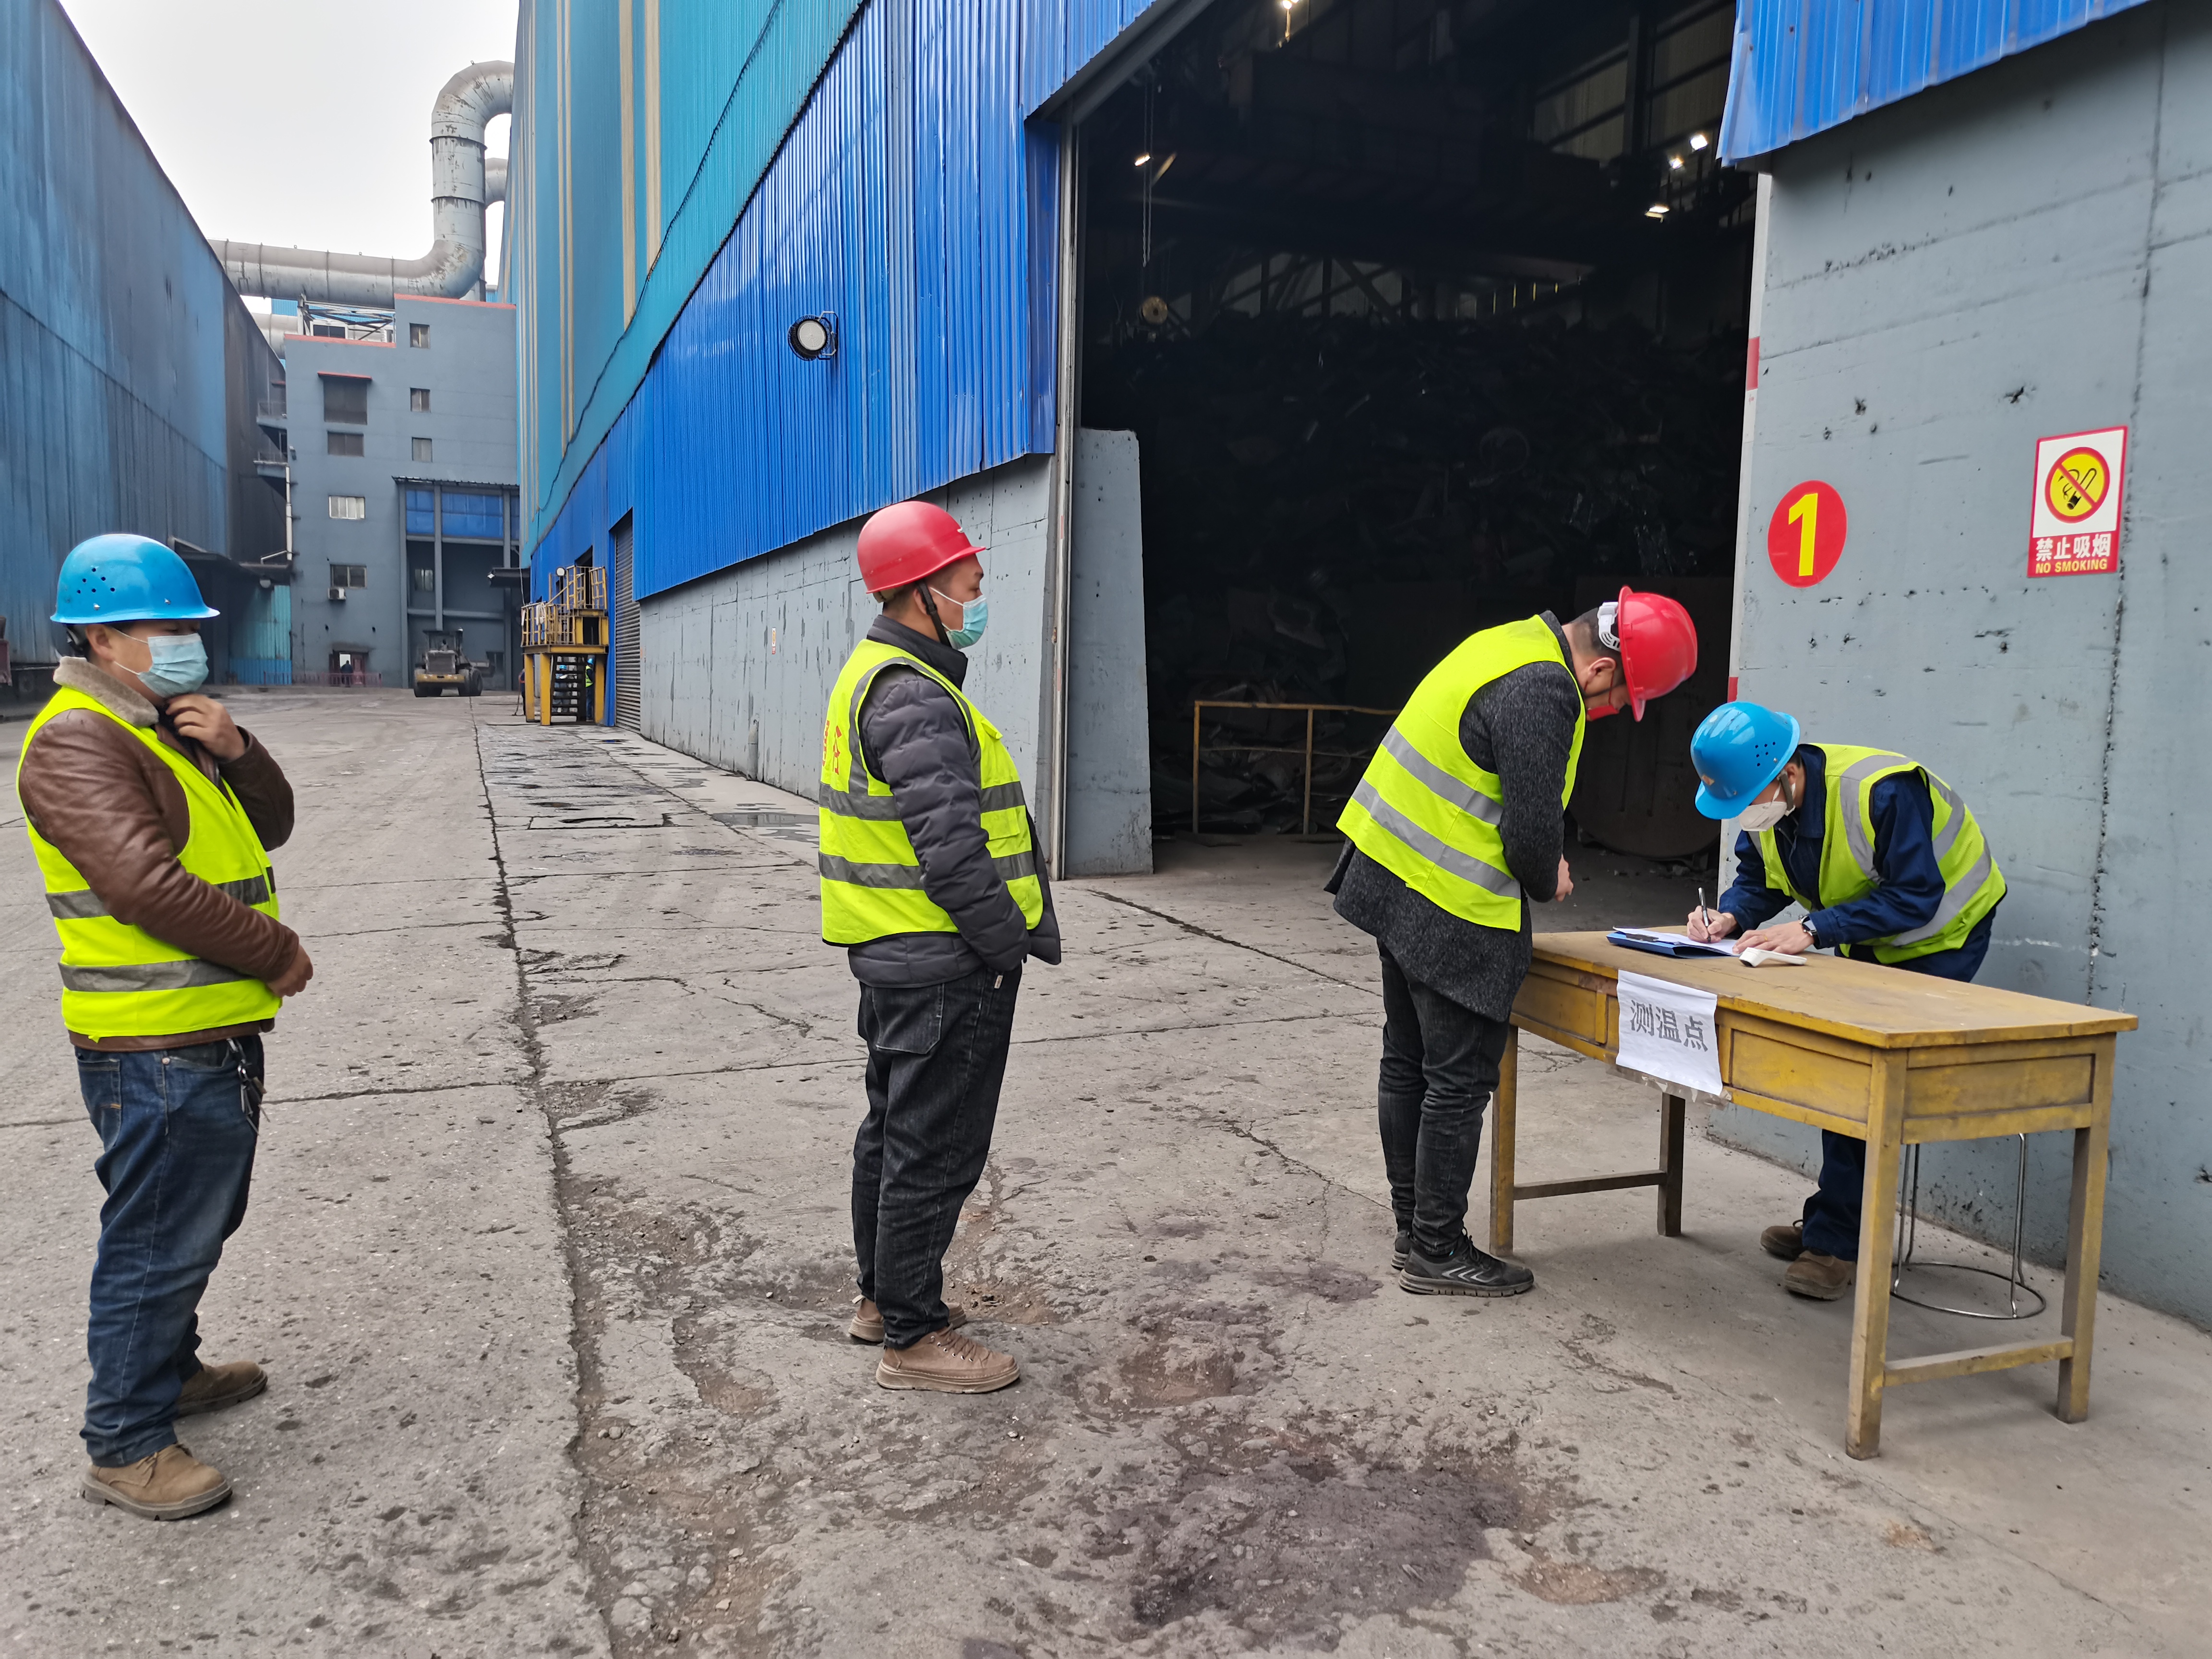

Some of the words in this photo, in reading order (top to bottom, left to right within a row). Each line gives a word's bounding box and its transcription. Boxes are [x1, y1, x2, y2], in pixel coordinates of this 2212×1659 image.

[1788, 493, 1818, 576] 1
[2036, 534, 2111, 562] 禁止吸烟
[2036, 563, 2051, 574] NO
[2055, 559, 2107, 573] SMOKING
[1630, 1000, 1708, 1052] 测温点
